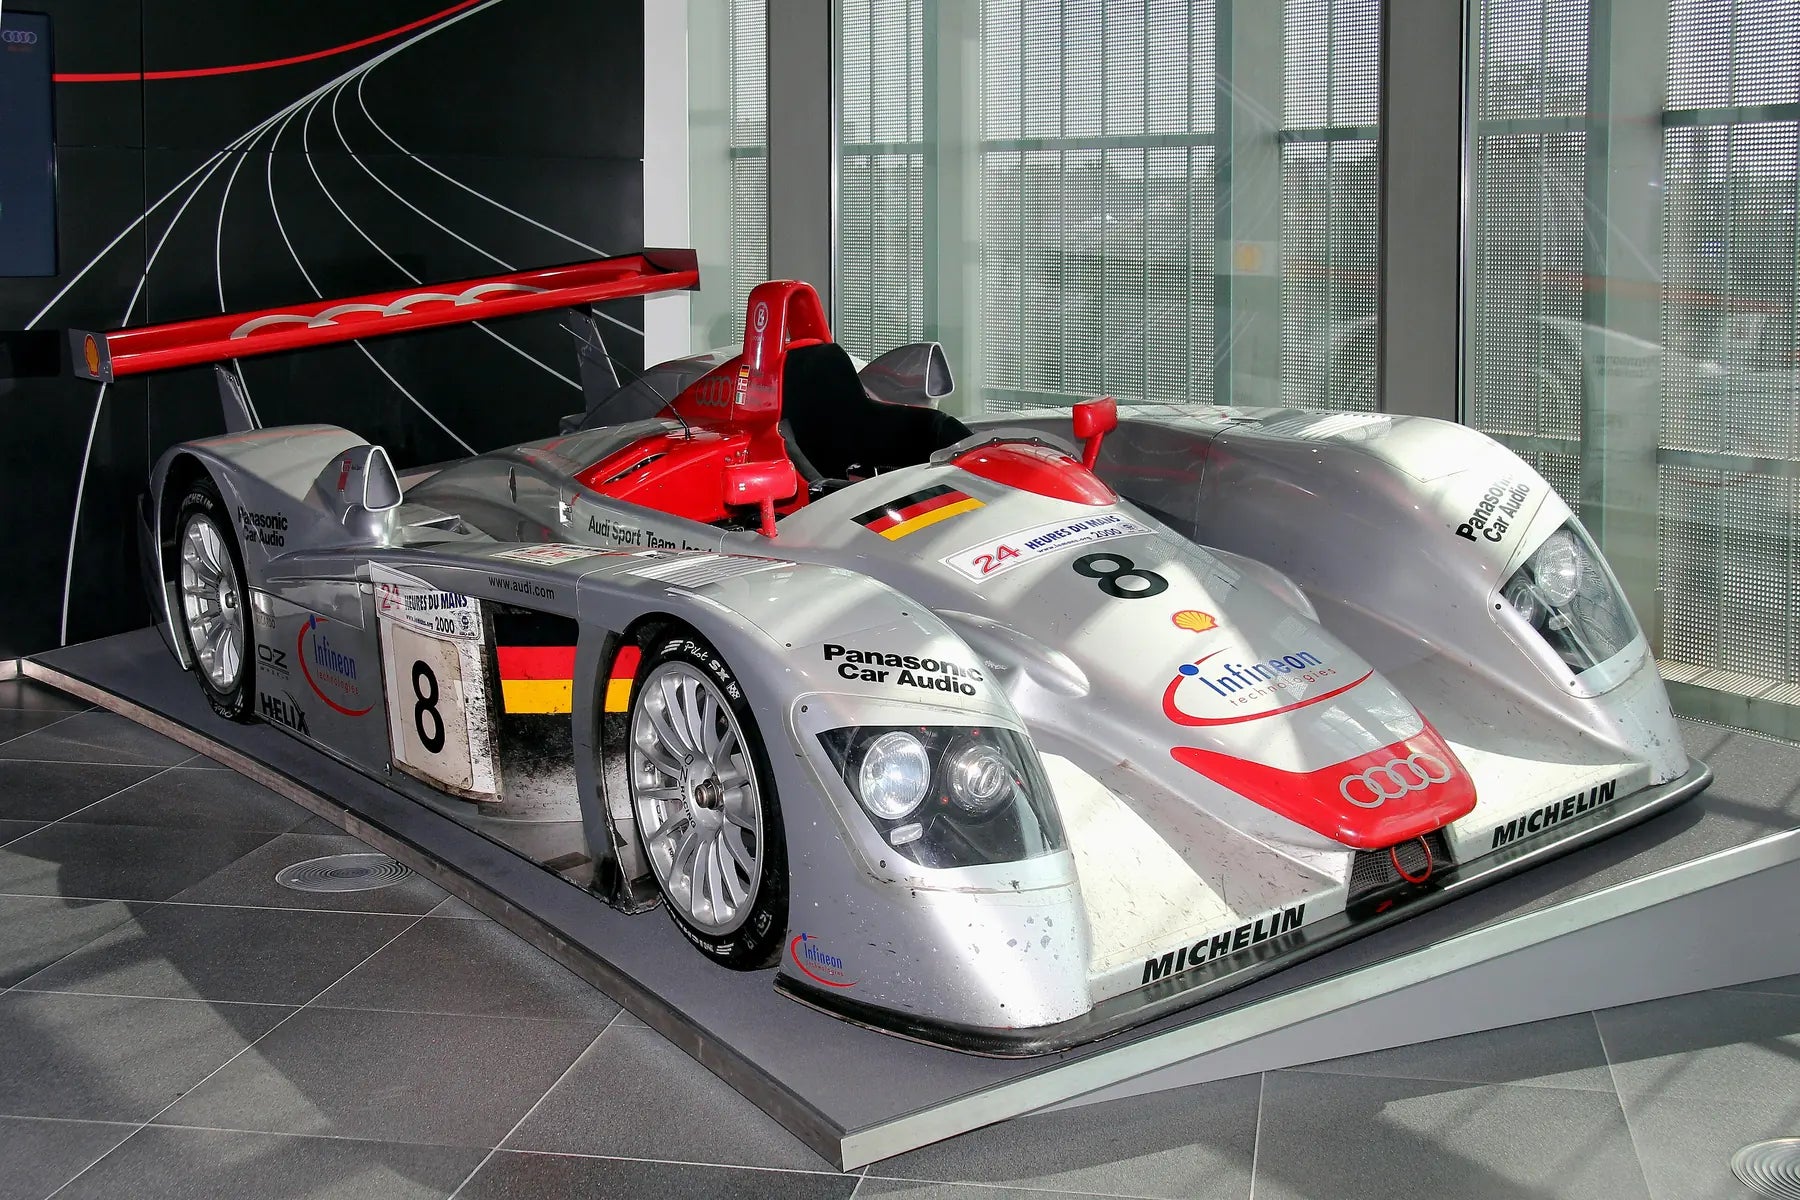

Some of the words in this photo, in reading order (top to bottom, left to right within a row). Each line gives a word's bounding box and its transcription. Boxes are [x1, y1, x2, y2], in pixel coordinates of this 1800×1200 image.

[238, 506, 288, 531] Panasonic
[1455, 473, 1513, 542] Panasoni
[1482, 515, 1510, 543] Car
[1498, 483, 1531, 519] Audio
[242, 524, 258, 543] Car
[259, 529, 285, 548] Audio
[588, 515, 610, 538] Audi
[611, 521, 642, 546] Sport
[645, 530, 676, 550] Team
[972, 543, 1020, 576] 24
[1024, 528, 1072, 550] HEURES
[1067, 522, 1089, 534] DU
[1085, 515, 1121, 528] MANS
[1089, 527, 1122, 539] 2000
[488, 575, 556, 600] www.audi.com
[1072, 552, 1169, 599] 8
[404, 593, 428, 612] HEURES
[428, 593, 440, 611] DU
[440, 590, 468, 610] MANS
[434, 615, 455, 634] 2000
[313, 634, 357, 680] Infineon
[684, 640, 709, 661] Pilot
[708, 660, 730, 682] SX
[823, 643, 984, 682] Panasonic
[1199, 649, 1323, 697] Infineon
[837, 662, 890, 684] Car
[896, 669, 977, 696] Audio
[1230, 667, 1337, 707] technologies
[260, 690, 311, 737] HELIX
[412, 660, 445, 754] 8
[1491, 778, 1617, 849] MICHELIN
[804, 942, 843, 970] Infineon
[1141, 903, 1306, 985] MICHELIN
